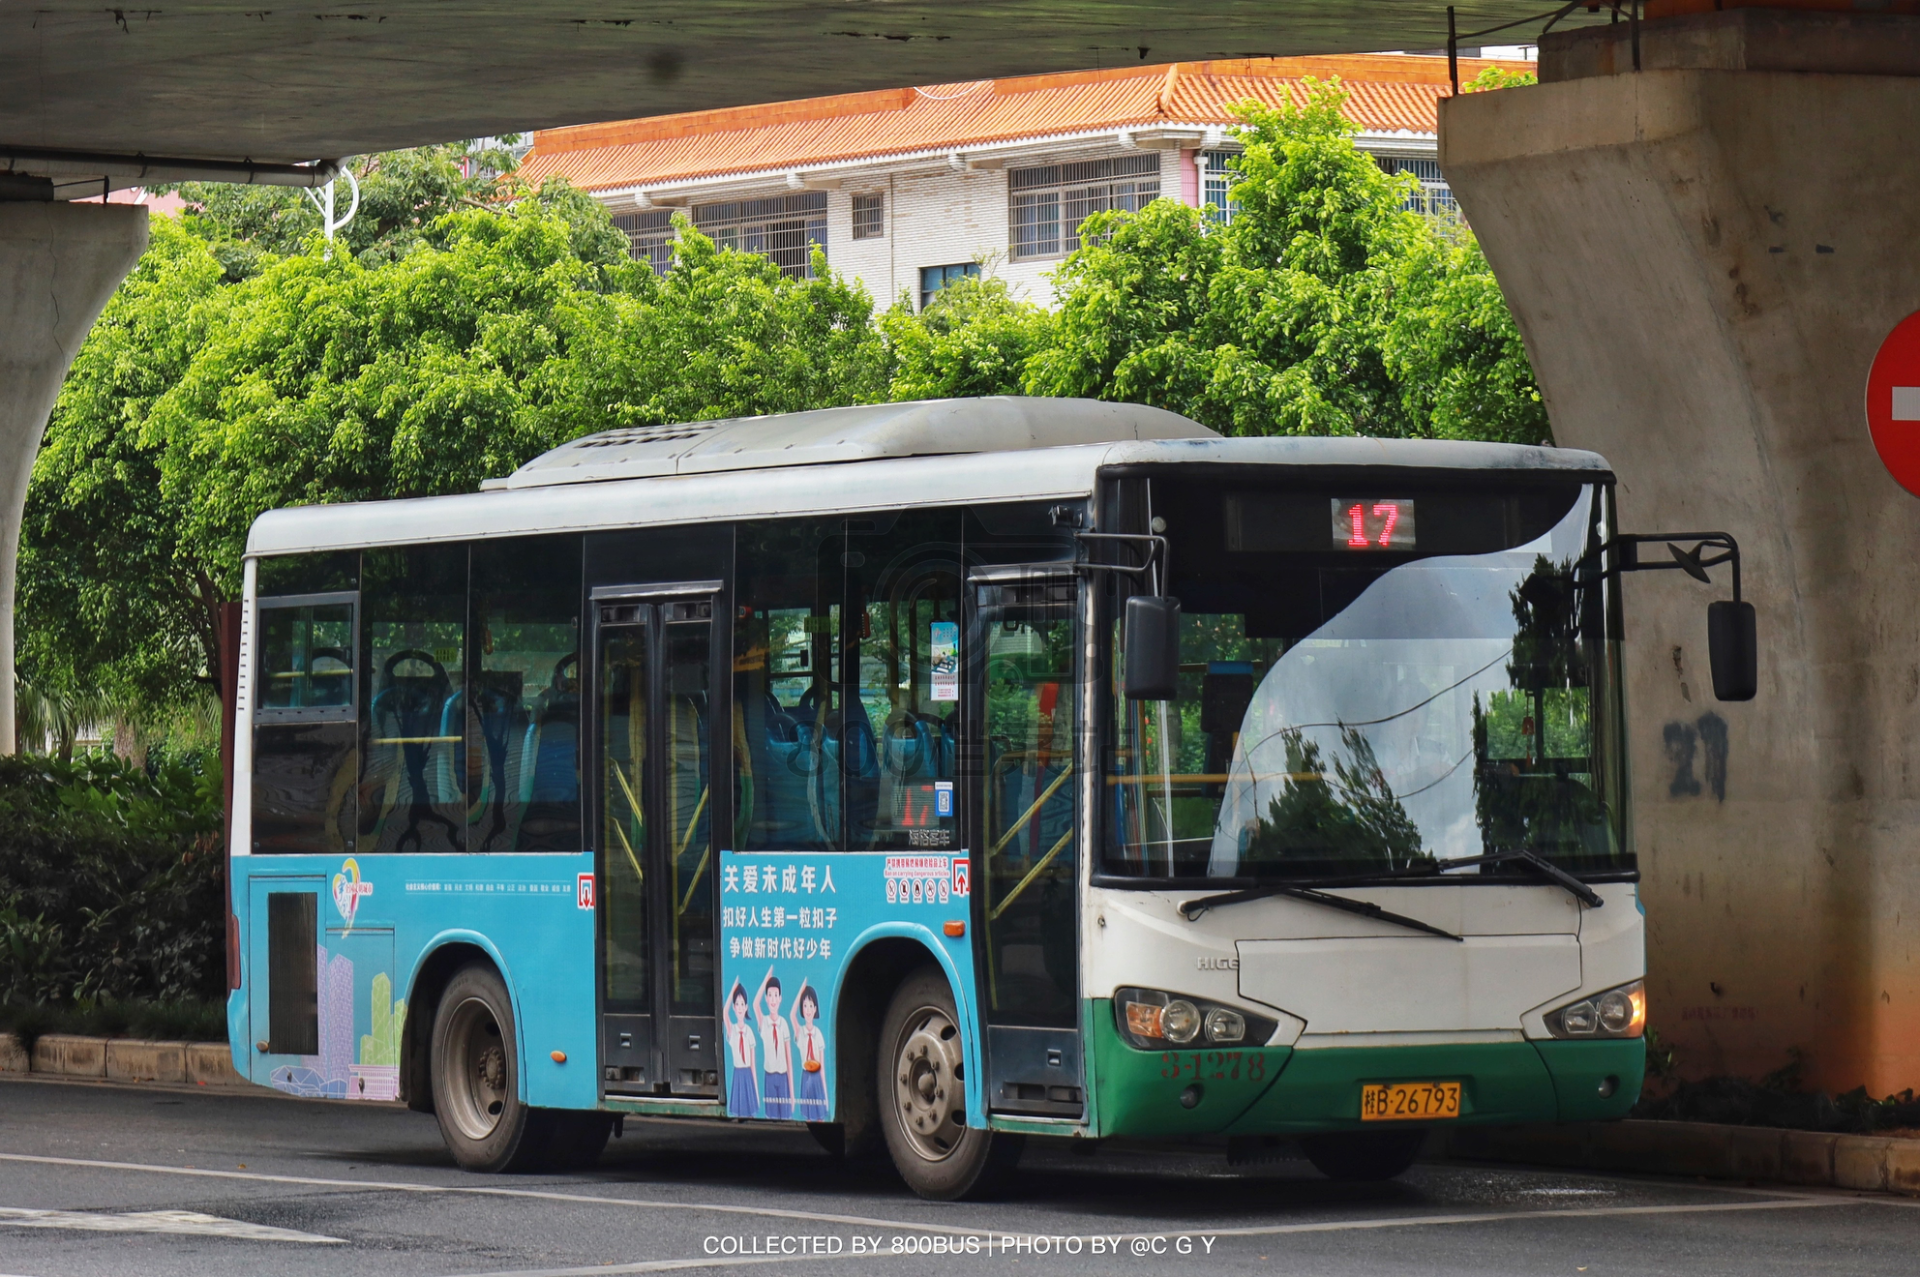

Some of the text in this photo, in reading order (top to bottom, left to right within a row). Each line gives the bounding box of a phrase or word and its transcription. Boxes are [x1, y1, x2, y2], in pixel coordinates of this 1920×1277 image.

[1347, 503, 1398, 547] 17
[724, 864, 837, 894] 关爱未成年人
[723, 906, 837, 929] 扣好人生第一粒扣子
[729, 936, 832, 960] 争做新时代好少年
[1161, 1051, 1266, 1082] 3-1278
